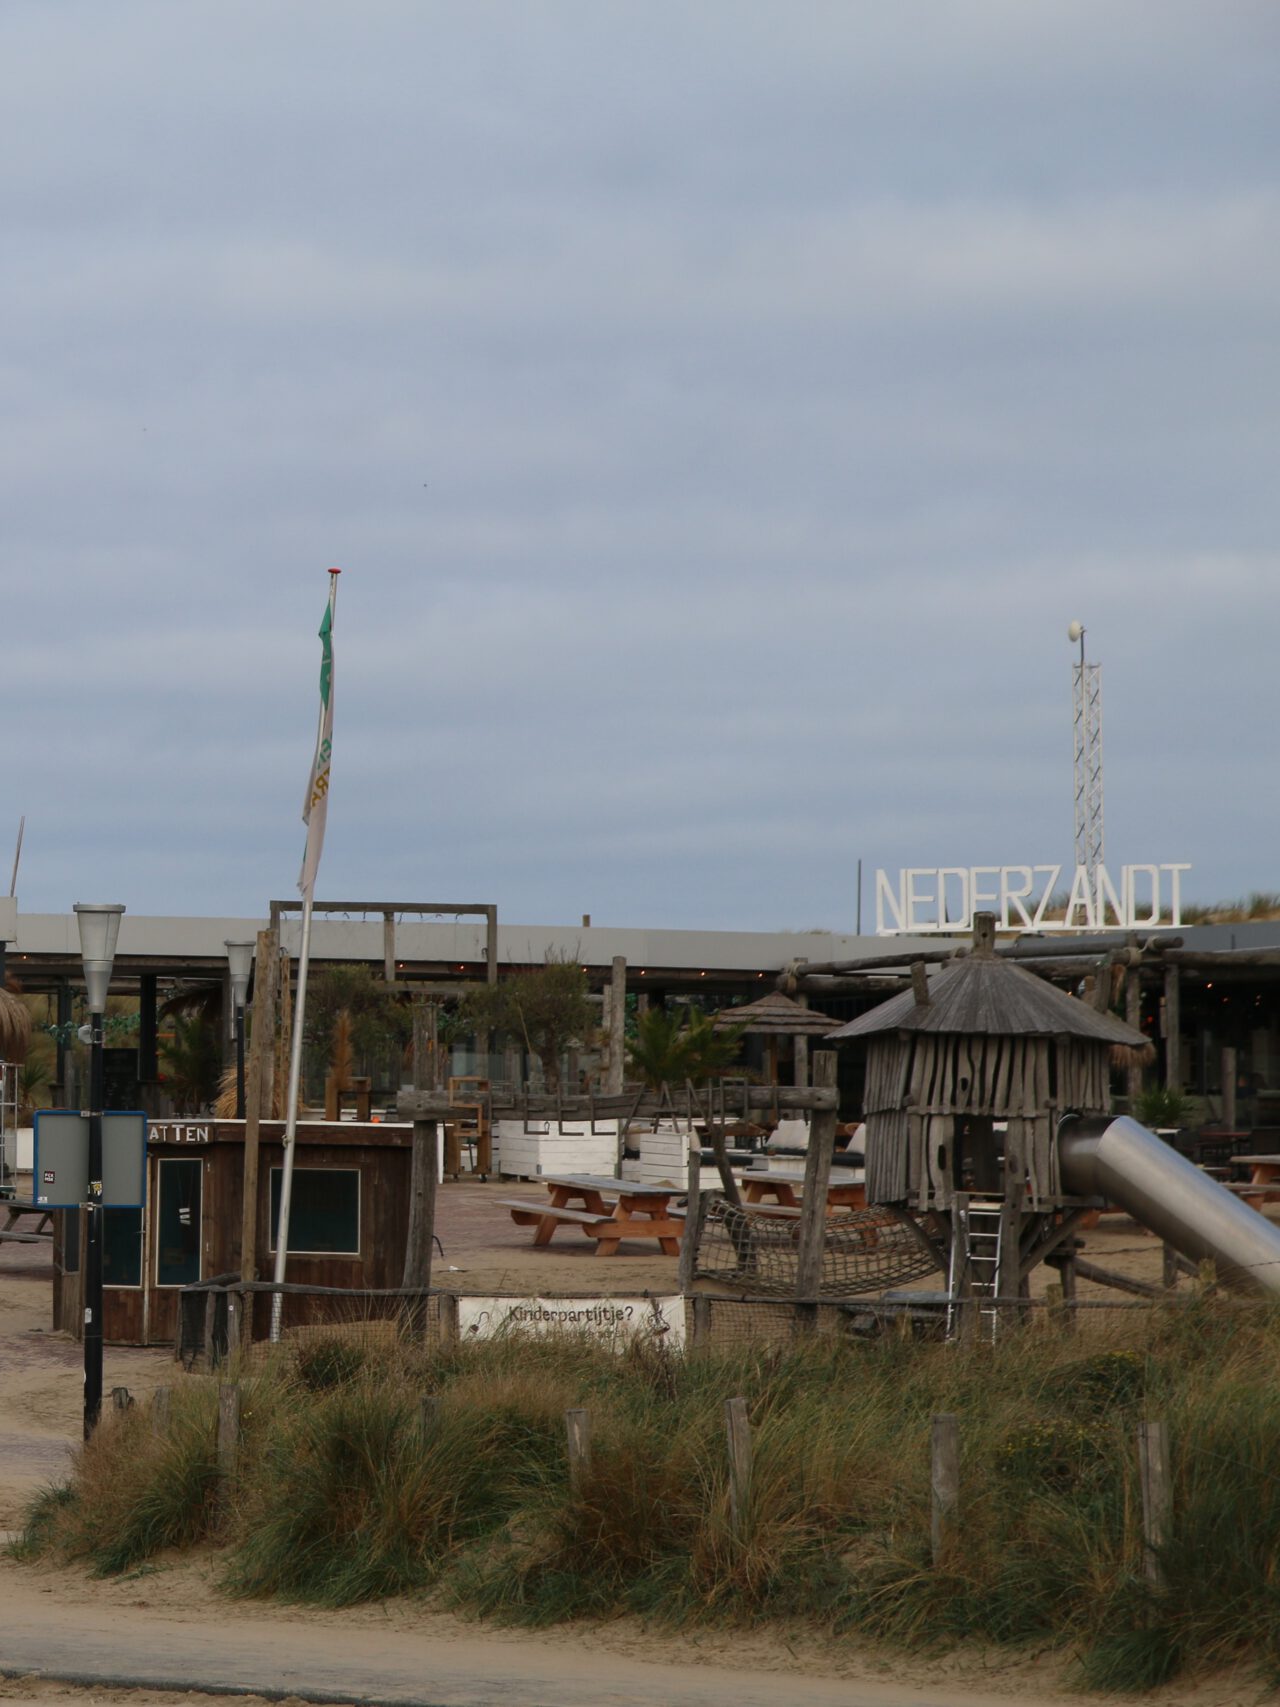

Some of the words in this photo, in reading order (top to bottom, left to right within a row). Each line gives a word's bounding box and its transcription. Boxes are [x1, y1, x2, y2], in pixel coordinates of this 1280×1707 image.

[876, 864, 1193, 931] NEDERZANDT
[149, 1124, 209, 1142] ATTEN
[509, 1305, 635, 1326] Kinderpartijtje?
